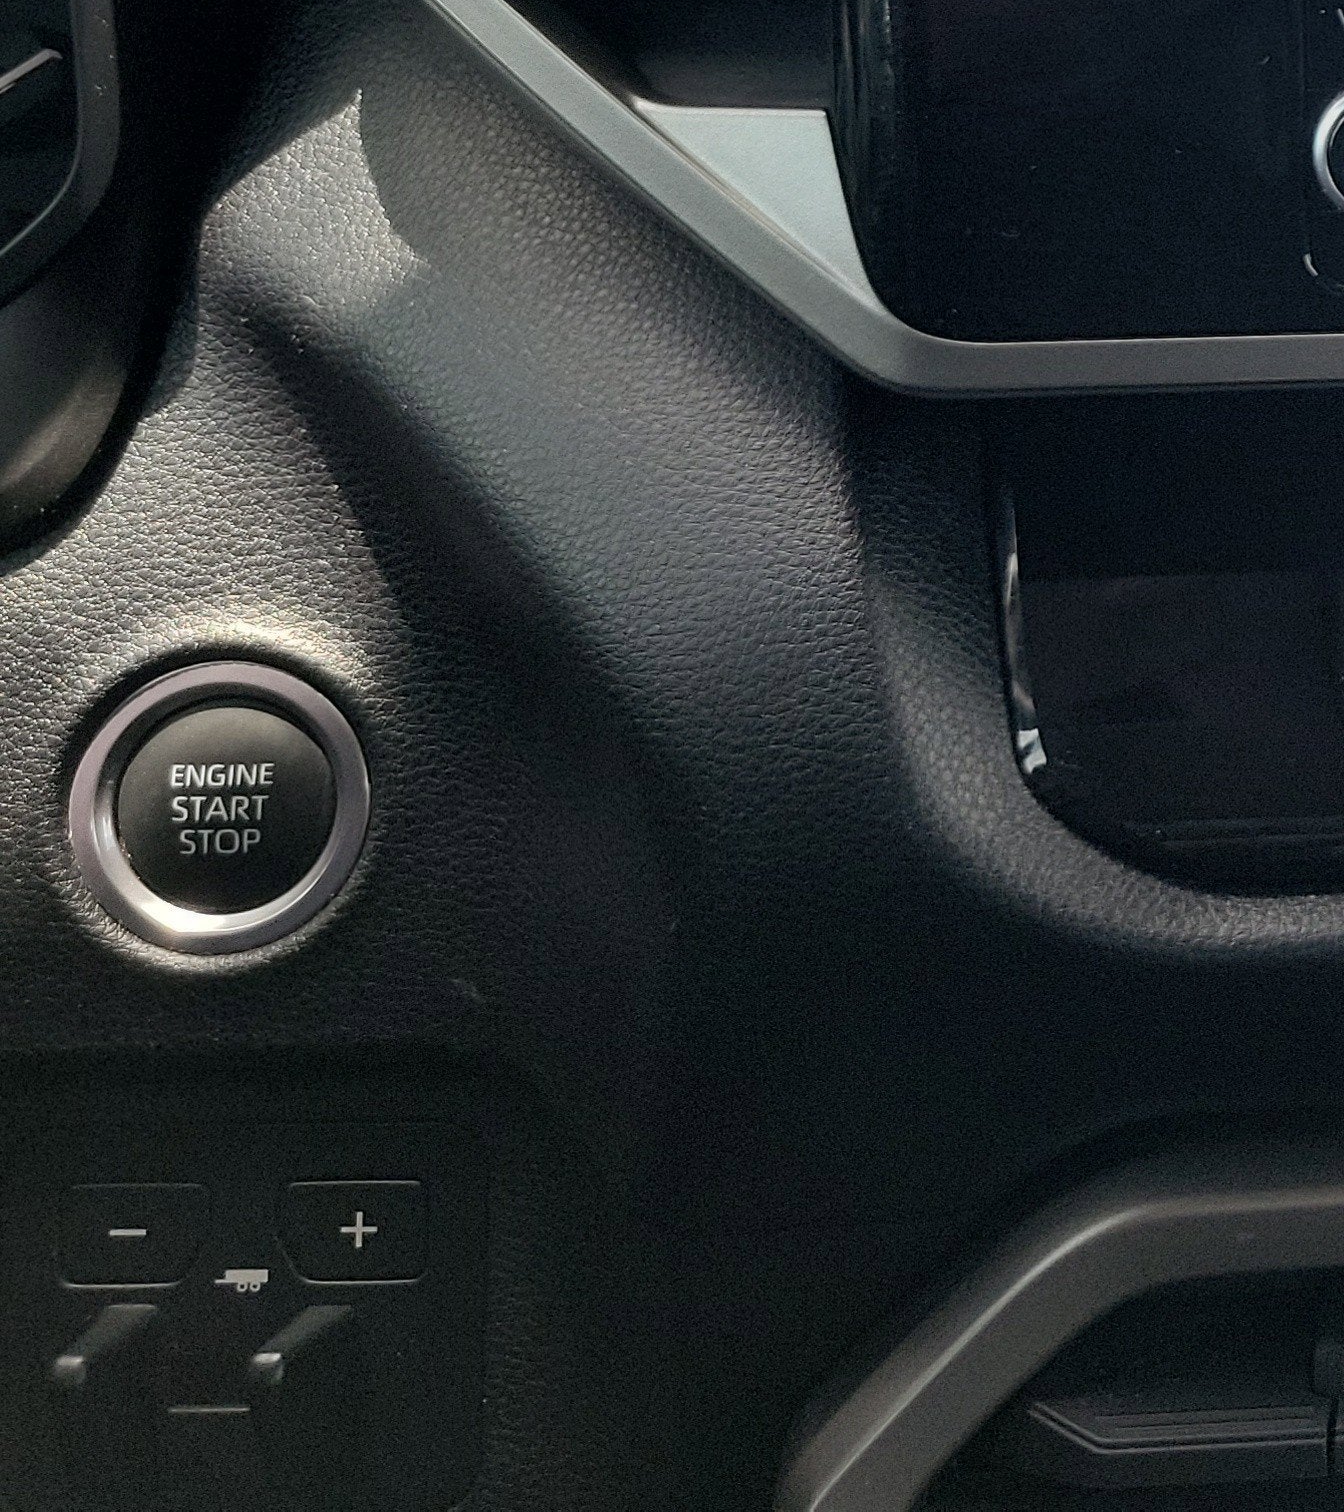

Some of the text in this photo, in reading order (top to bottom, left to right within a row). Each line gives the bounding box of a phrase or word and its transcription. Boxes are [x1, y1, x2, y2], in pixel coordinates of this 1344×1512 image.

[170, 763, 275, 788] ENGINE
[171, 795, 269, 823] START
[179, 828, 261, 854] STOP
